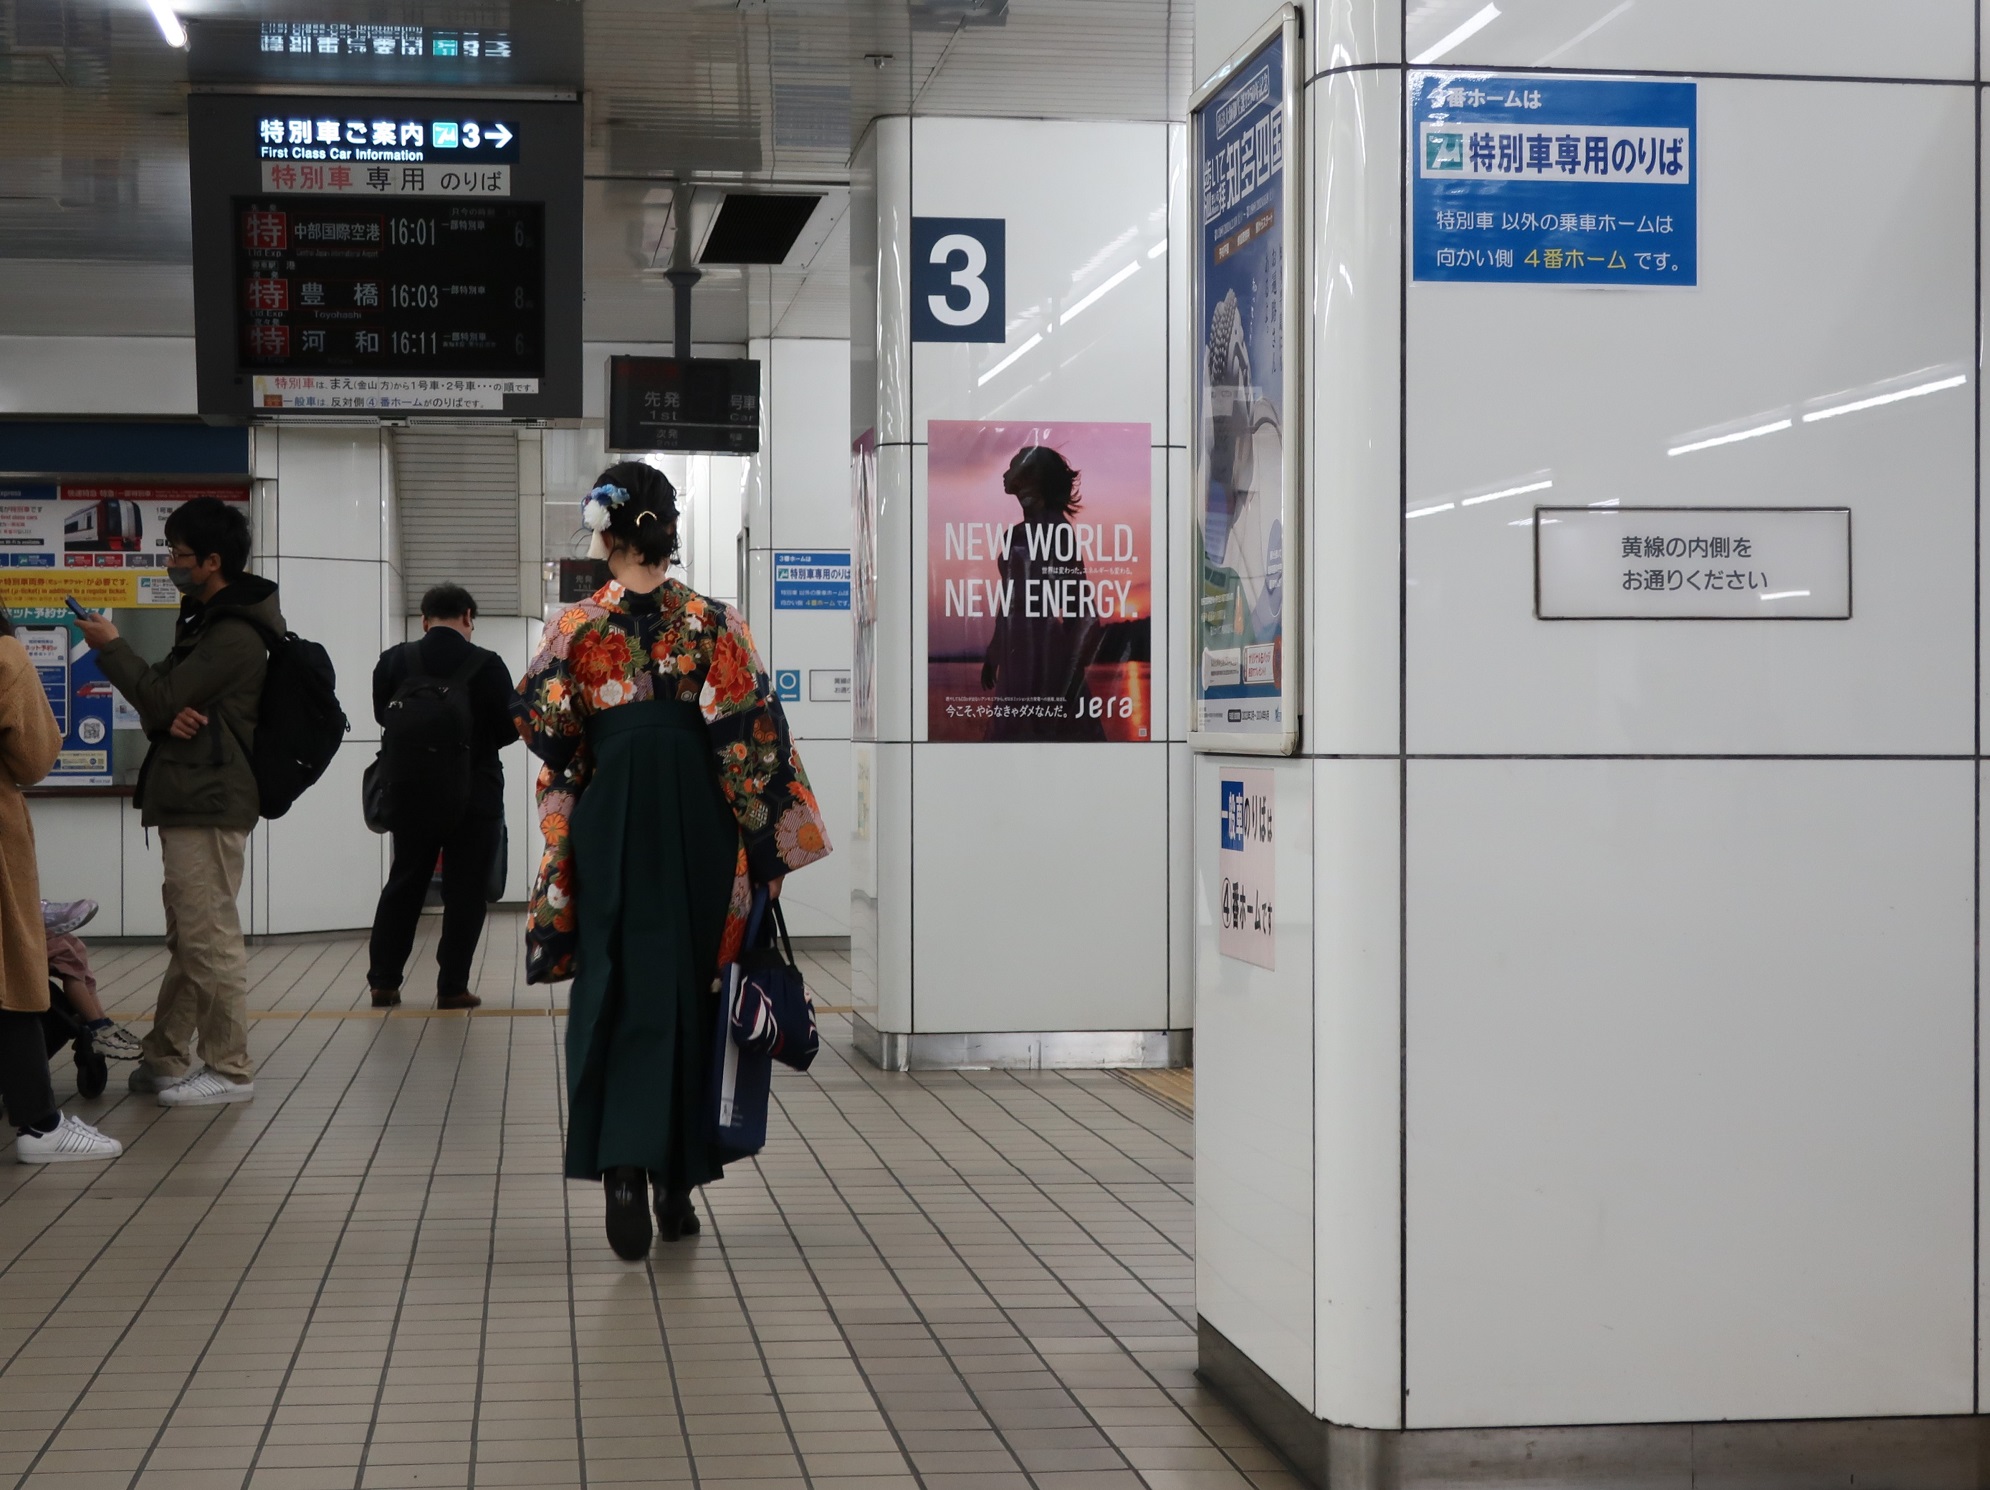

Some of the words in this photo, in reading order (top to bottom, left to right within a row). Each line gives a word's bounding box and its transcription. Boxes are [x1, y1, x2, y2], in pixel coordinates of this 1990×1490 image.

[260, 119, 424, 147] 特別車ご案内
[462, 122, 481, 149] 3
[260, 146, 288, 159] First
[292, 147, 326, 160] Class
[329, 147, 352, 160] Car
[355, 148, 424, 162] Information
[1469, 132, 1684, 176] 特別車専用のりば
[271, 163, 353, 190] 特別車
[440, 170, 502, 192] のりば
[247, 213, 282, 248] 特
[293, 222, 381, 242] 中部国際空港
[389, 217, 436, 246] 16:01
[1436, 211, 1494, 230] 特別車
[1501, 212, 1674, 234] 以外の乗車ホームは
[1436, 247, 1513, 268] 向かい側
[1634, 252, 1680, 272] です。
[927, 233, 990, 327] 3
[249, 280, 284, 308] 特
[390, 284, 439, 309] 16:03
[250, 327, 286, 355] 特
[391, 330, 438, 355] 16:11
[644, 391, 681, 408] 先発
[650, 411, 678, 422] 1st
[730, 413, 754, 422] Car
[945, 522, 1014, 561] NEW
[1025, 523, 1139, 562] WORLD.
[1621, 536, 1752, 558] 黄線の内側を
[1622, 569, 1768, 592] お通りください
[945, 579, 1015, 617] NEW
[1025, 579, 1139, 618] ENERGY.
[945, 704, 1068, 719] 今こそ、やらなきゃダメなんだ。
